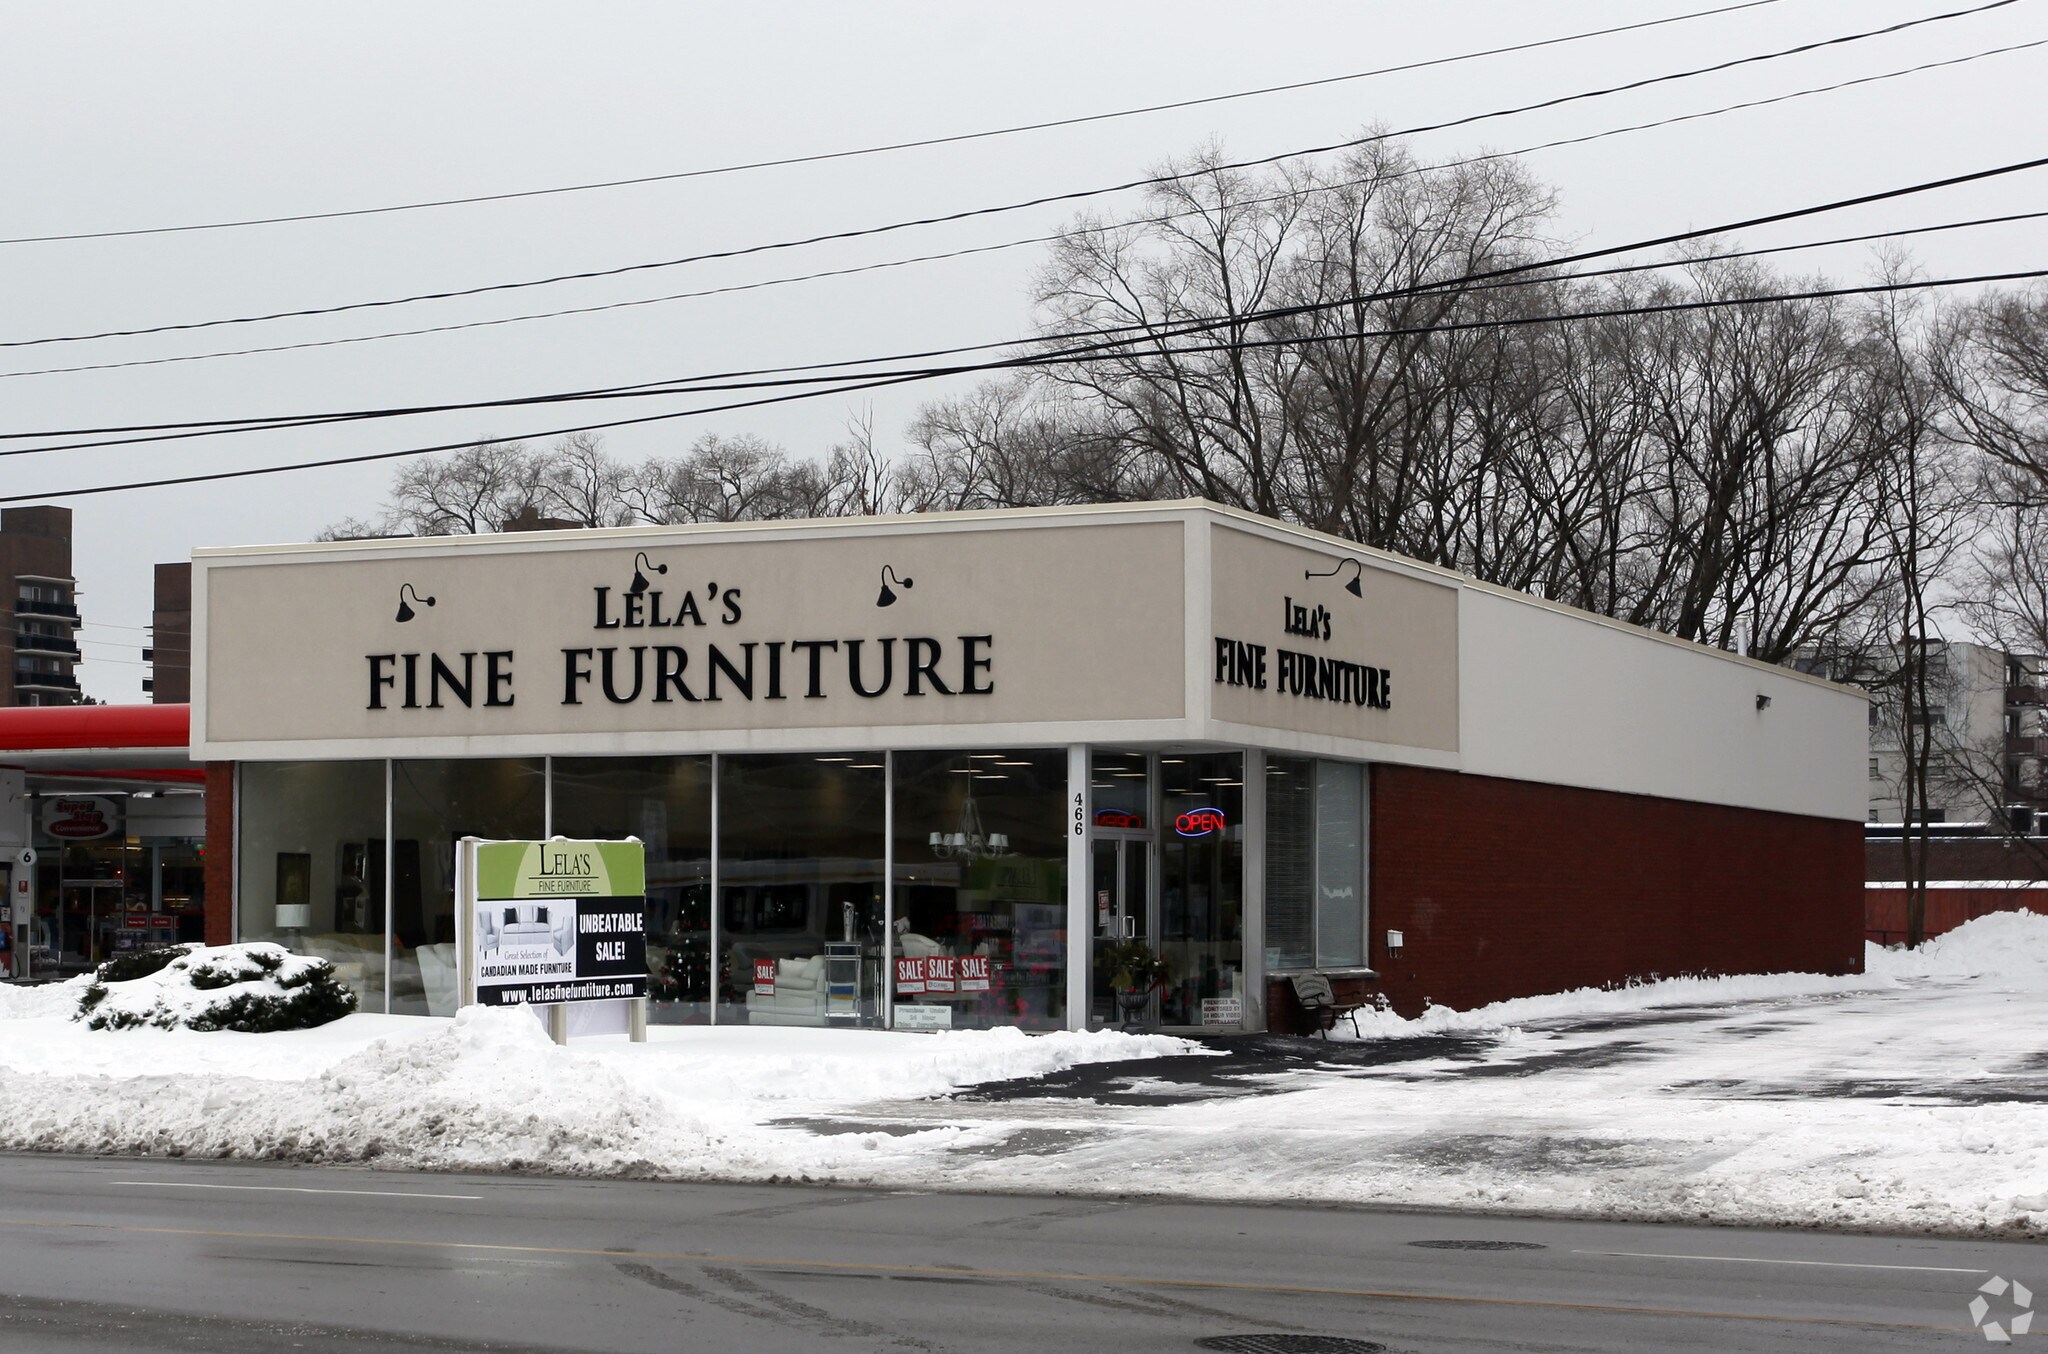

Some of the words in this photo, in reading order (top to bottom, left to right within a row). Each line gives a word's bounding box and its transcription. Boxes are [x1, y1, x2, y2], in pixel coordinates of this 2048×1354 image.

[593, 582, 742, 629] LELA'S
[1284, 596, 1331, 641] LELA'S
[365, 650, 515, 709] FINE
[560, 633, 995, 705] FURNITURE
[1215, 637, 1267, 689] FINE
[1277, 649, 1391, 709] FURNITURE
[1074, 793, 1083, 836] 466
[1175, 814, 1225, 832] OPEN
[23, 851, 32, 863] 6
[538, 843, 591, 876] LELA'S
[538, 881, 555, 892] FINE
[557, 880, 591, 892] FURNITURE
[579, 912, 643, 934] UNBEATABLE
[504, 950, 519, 961] Great
[519, 949, 542, 960] Selection
[595, 941, 626, 962] SALE!
[480, 963, 517, 978] CANDADIAN
[518, 963, 539, 976] MADE
[540, 962, 572, 974] FURNITURE
[757, 965, 774, 979] SALE
[898, 960, 924, 980] SALE
[929, 958, 954, 979] SALE
[961, 958, 988, 978] SALE
